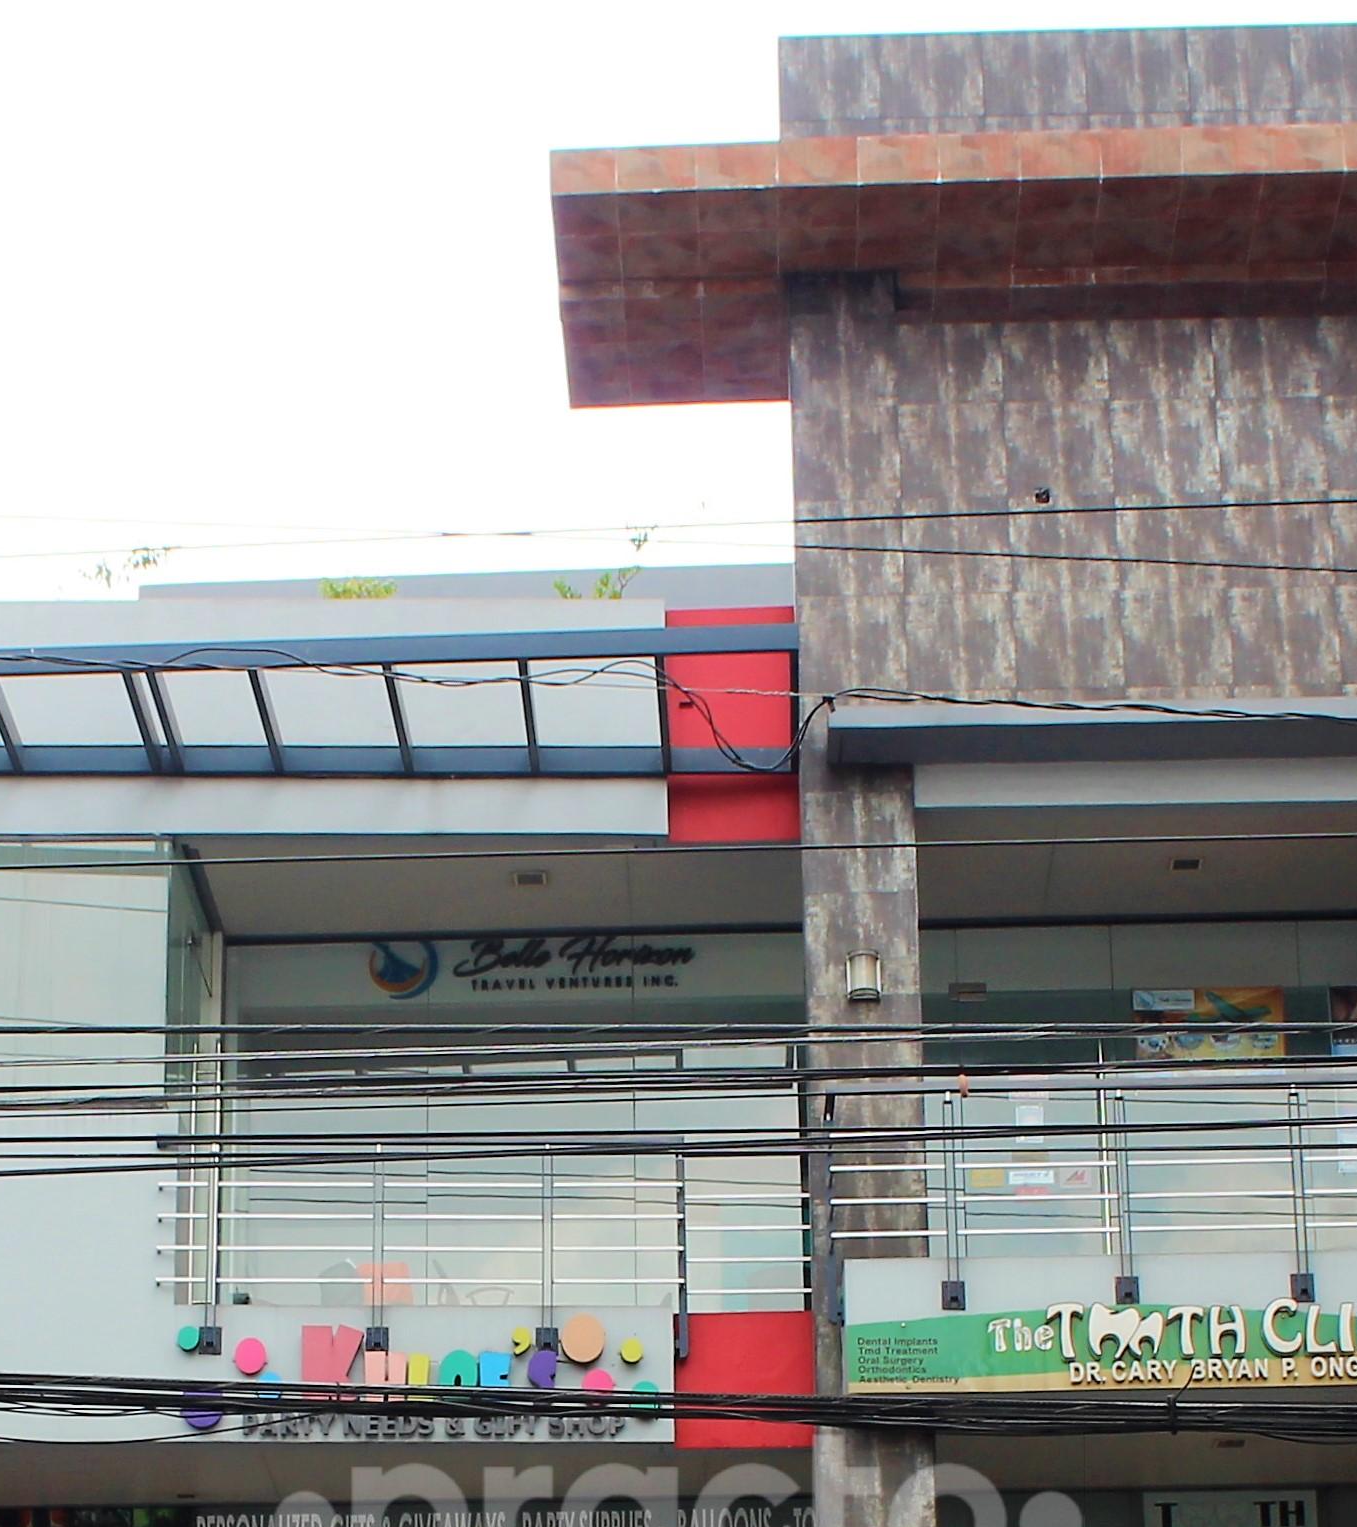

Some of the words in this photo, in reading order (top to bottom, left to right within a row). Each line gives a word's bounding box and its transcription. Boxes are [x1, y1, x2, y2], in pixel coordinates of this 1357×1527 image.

[987, 1317, 1054, 1354] The
[857, 1337, 891, 1346] Dental
[894, 1337, 938, 1348] Implants
[885, 1346, 939, 1355] Treatment
[858, 1356, 880, 1365] Oral
[883, 1356, 925, 1366] Surgery
[858, 1365, 927, 1374] Orthodontics
[1069, 1361, 1107, 1385] DR.
[1191, 1358, 1268, 1382] BRYAN
[1282, 1356, 1299, 1379] P.
[243, 1413, 336, 1438] PARTY
[343, 1414, 435, 1438] NEEDS
[473, 1415, 541, 1437] GIFT
[547, 1415, 627, 1437] SHOP
